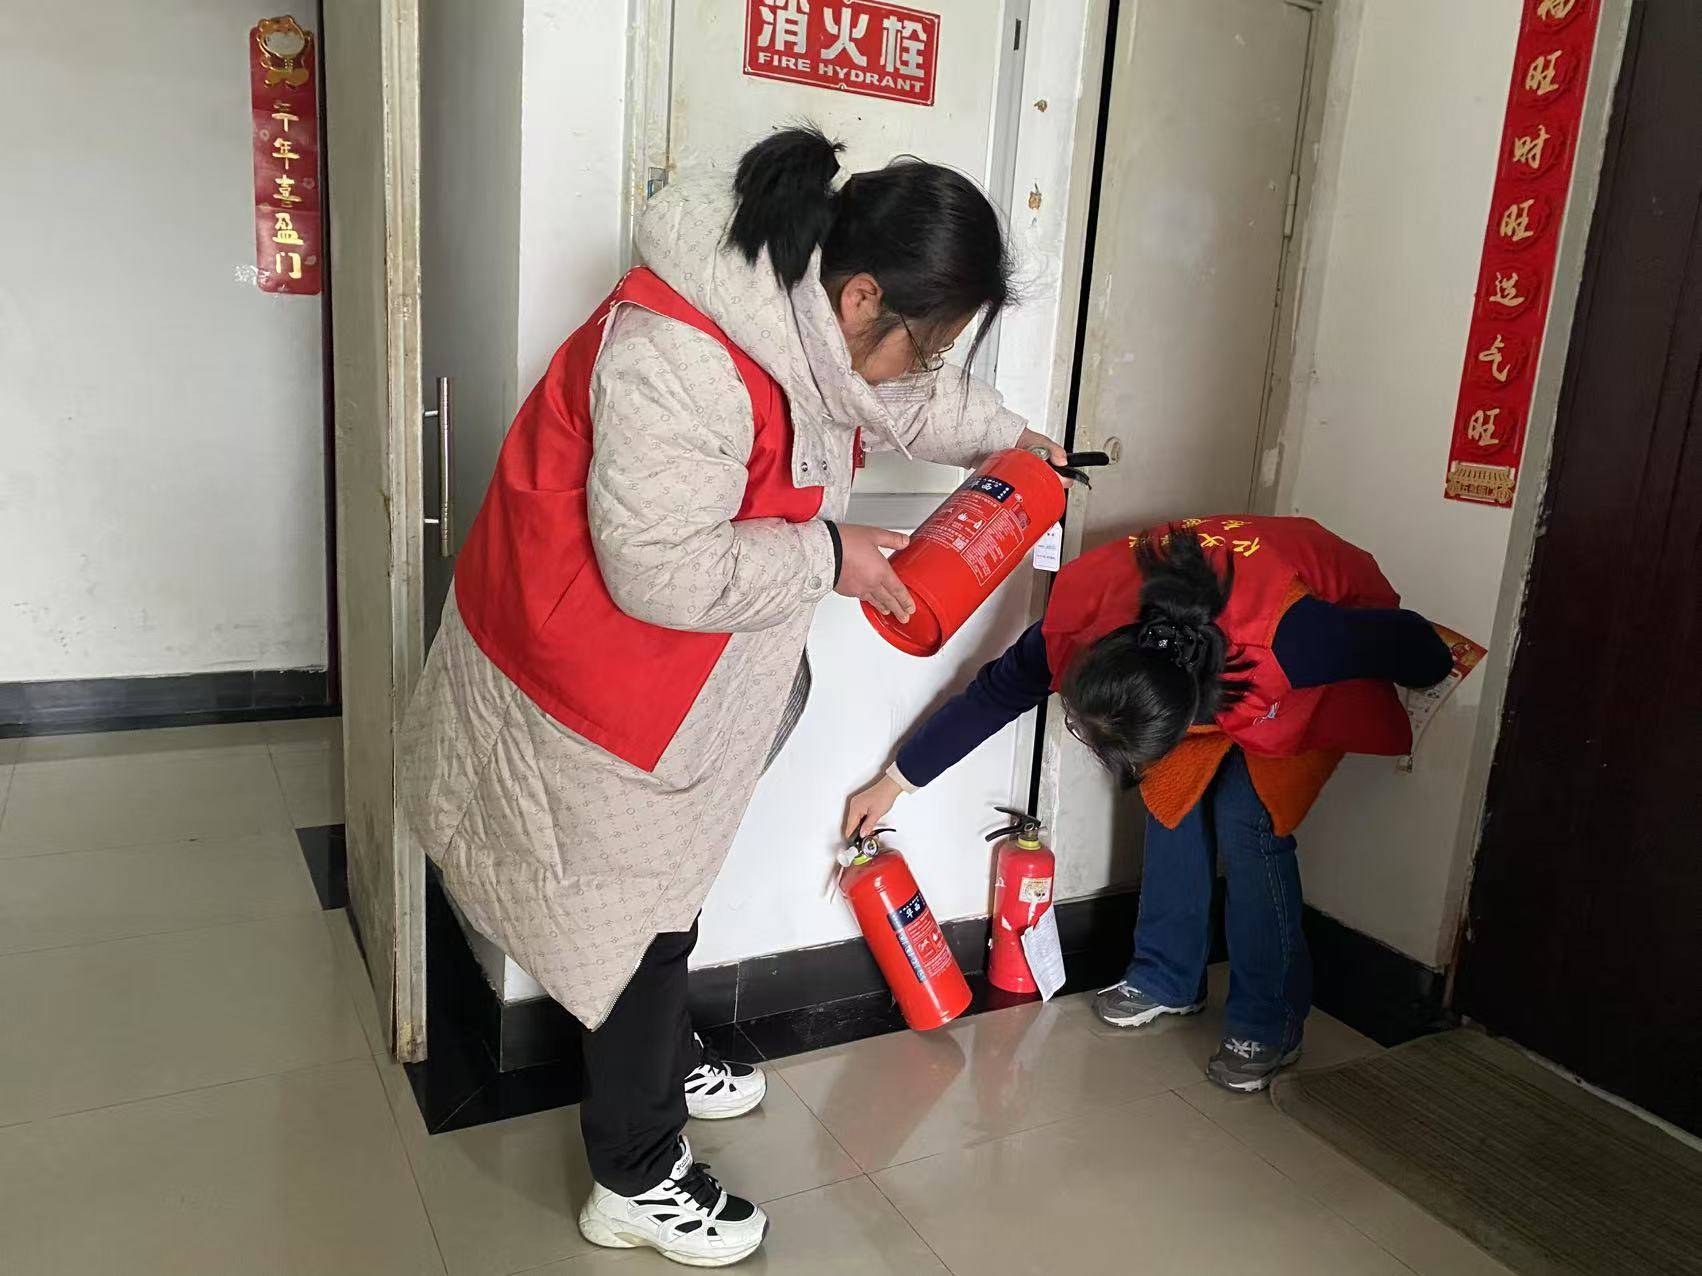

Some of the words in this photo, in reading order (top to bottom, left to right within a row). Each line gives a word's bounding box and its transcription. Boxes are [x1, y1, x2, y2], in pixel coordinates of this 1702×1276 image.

[757, 0, 927, 78] 消火栓
[758, 52, 811, 71] FIRE
[818, 63, 925, 92] HYDRANT
